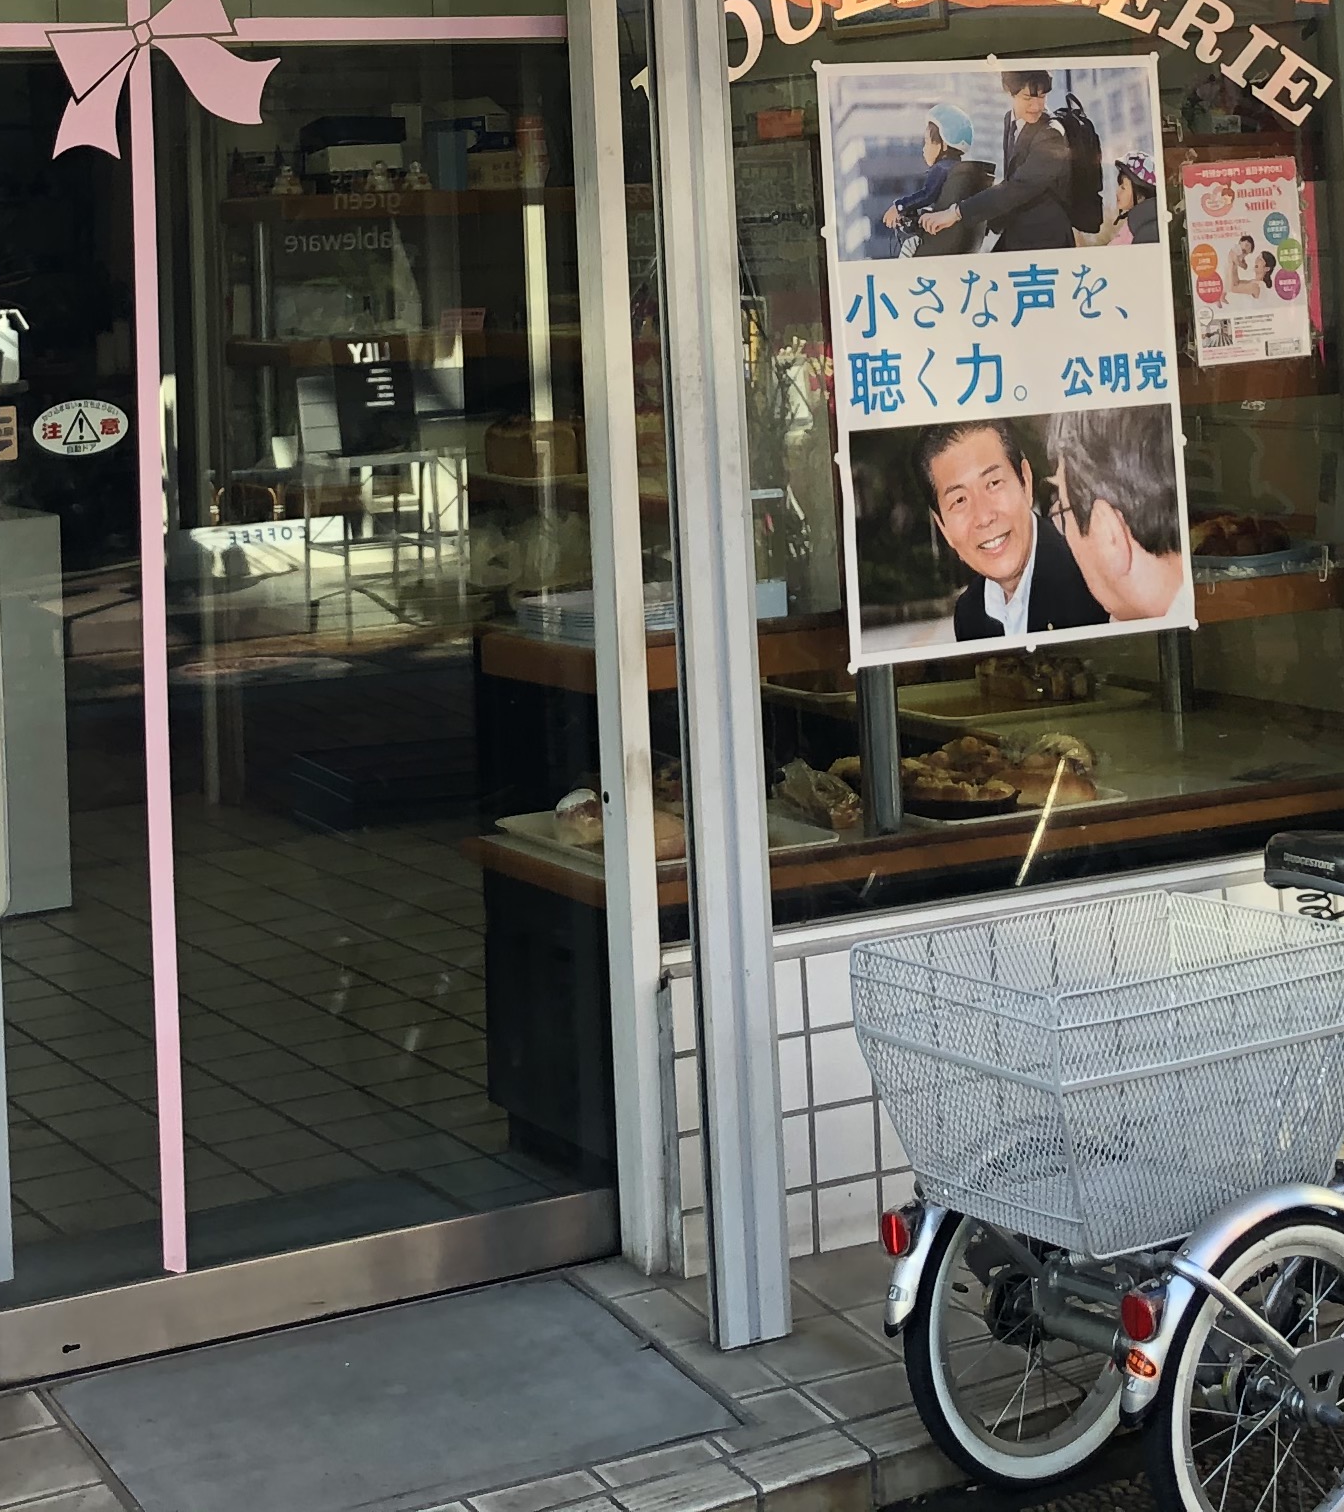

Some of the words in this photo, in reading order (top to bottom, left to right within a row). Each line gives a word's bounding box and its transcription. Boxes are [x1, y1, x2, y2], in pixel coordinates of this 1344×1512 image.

[1236, 185, 1283, 199] mama's
[1244, 198, 1277, 211] smile
[846, 264, 1130, 340] 小さな声を、
[849, 343, 1029, 416] 聴く力。
[1060, 349, 1168, 400] 公明党
[42, 422, 63, 440] 注
[99, 418, 120, 435] 意
[66, 444, 97, 454] 自動ドア
